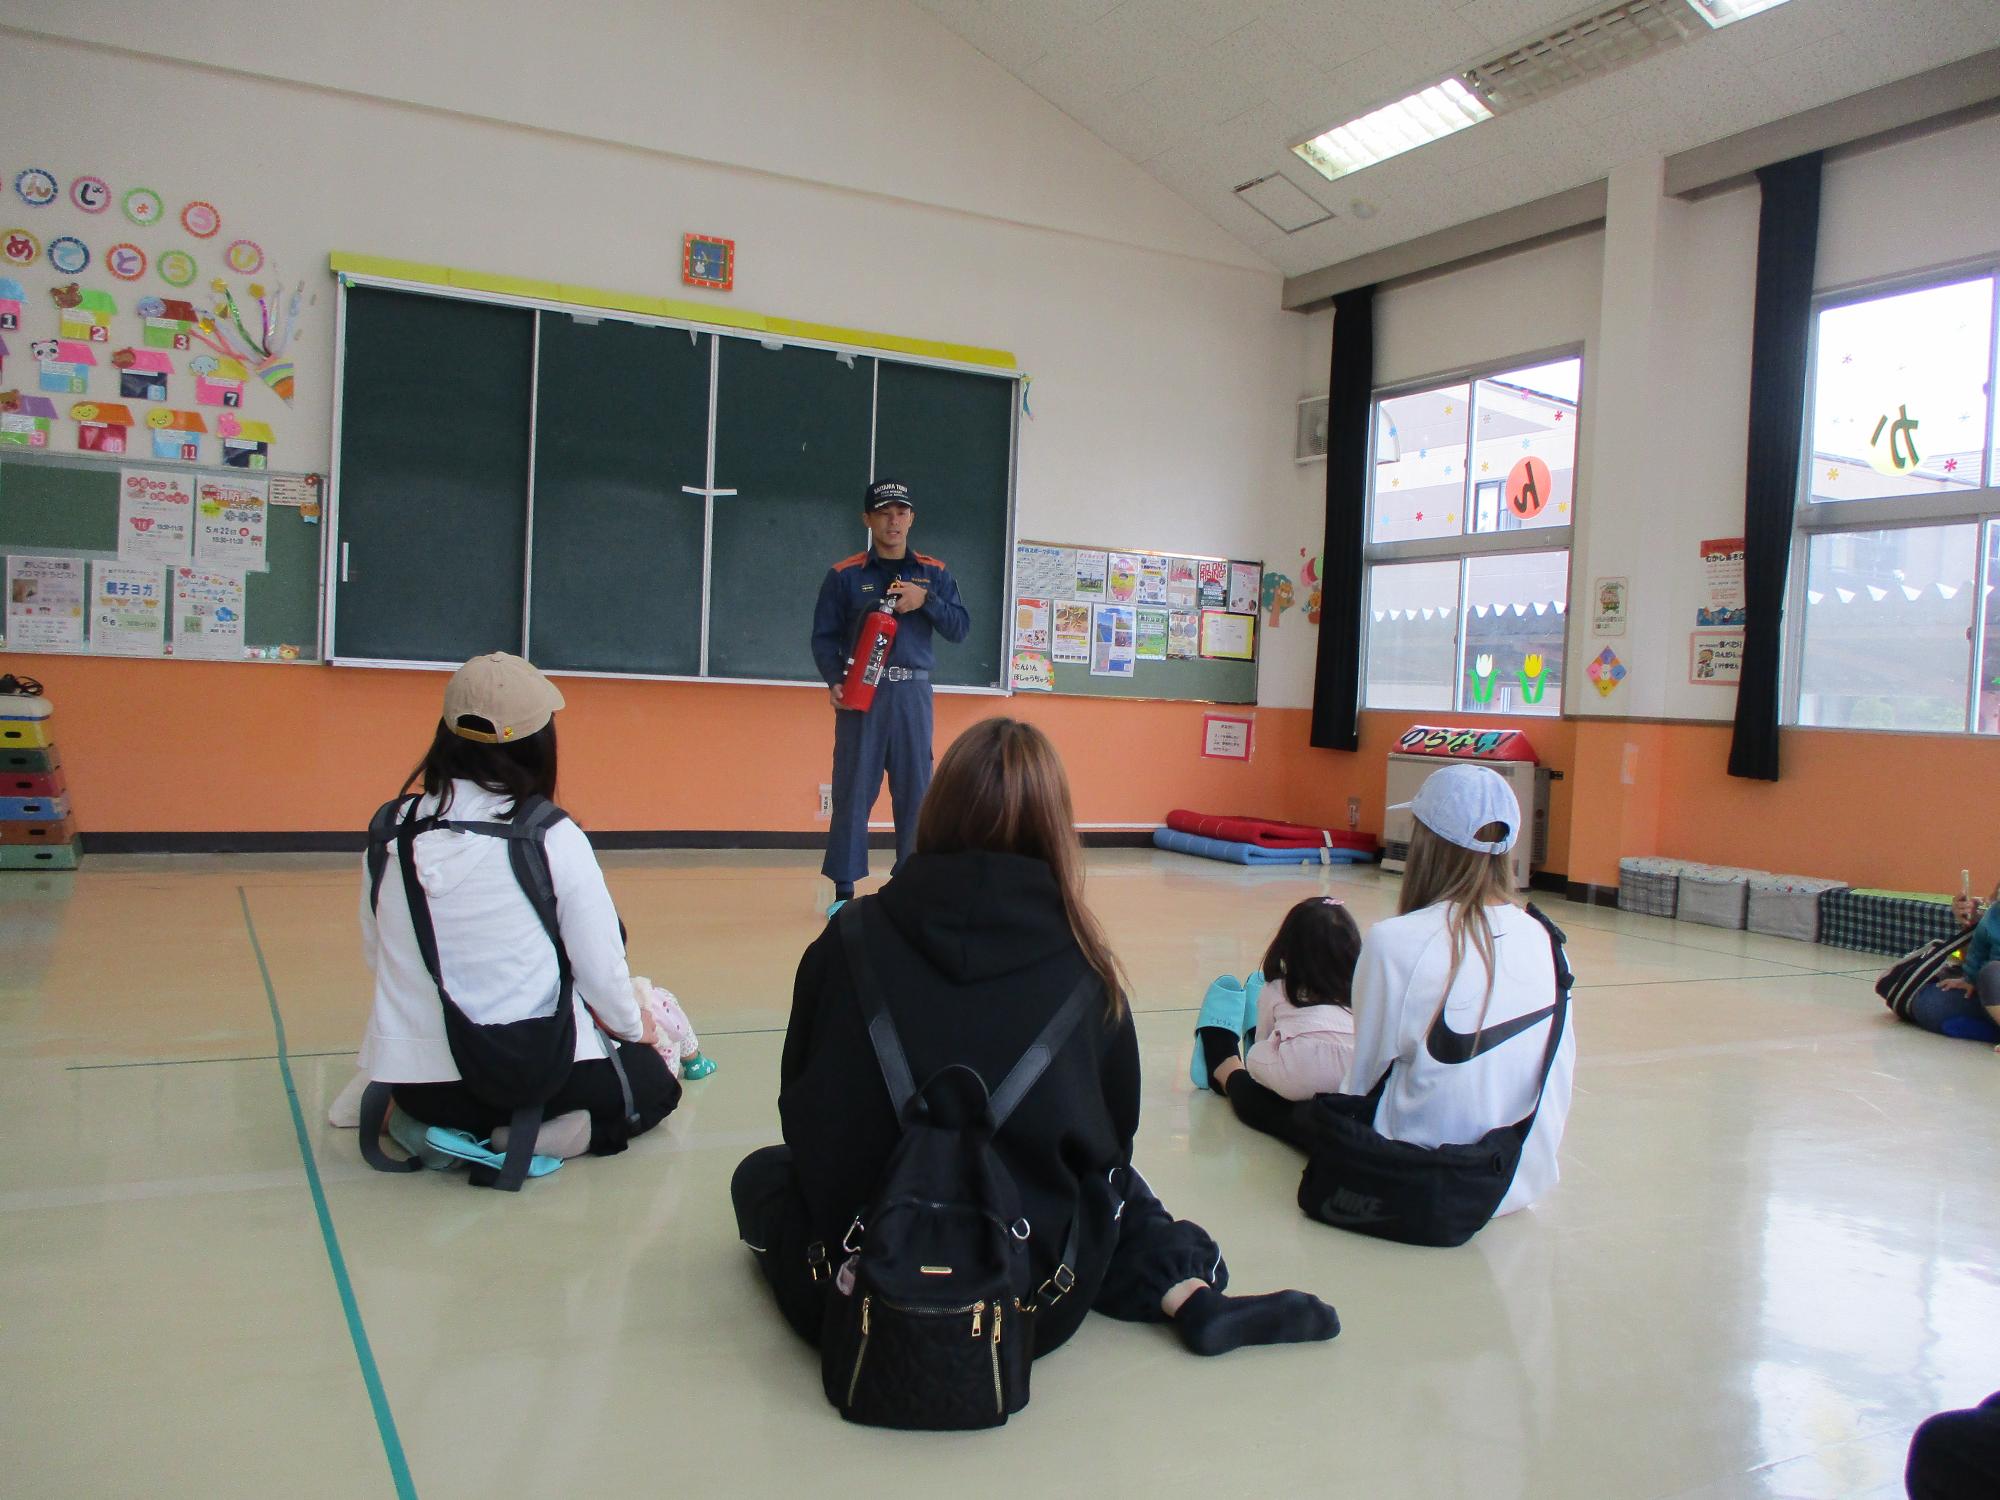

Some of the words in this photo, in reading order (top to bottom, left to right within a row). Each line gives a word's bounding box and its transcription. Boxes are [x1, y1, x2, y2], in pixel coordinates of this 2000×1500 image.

[6, 315, 15, 328] 1
[92, 326, 104, 340] 2
[177, 335, 188, 348] 3
[227, 393, 237, 406] 7
[182, 445, 196, 459] 11
